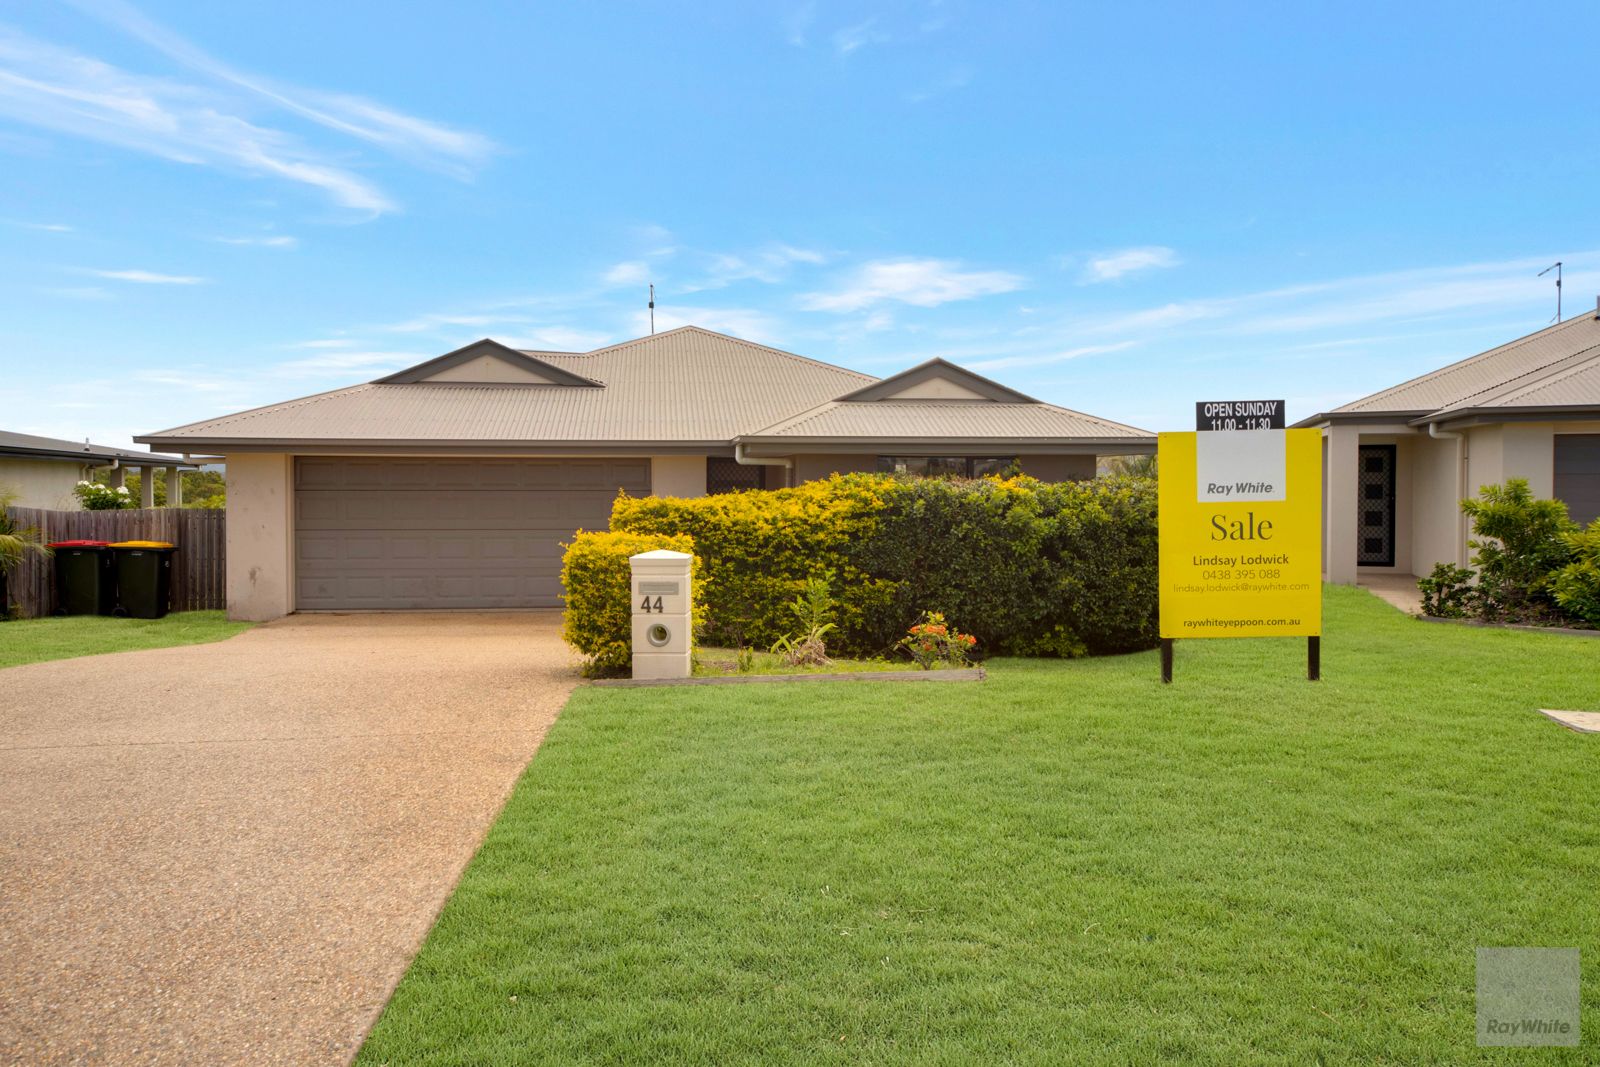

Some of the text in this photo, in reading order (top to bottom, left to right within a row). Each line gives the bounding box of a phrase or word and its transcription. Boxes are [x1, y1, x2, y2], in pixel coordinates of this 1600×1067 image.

[1204, 401, 1277, 417] OPEN SUNDAY
[1211, 418, 1236, 431] 11.00
[1245, 418, 1271, 430] 11.30
[1207, 482, 1273, 496] Ray White
[1211, 512, 1273, 541] Sale
[1193, 554, 1289, 568] Lindsay Lodwick
[1202, 569, 1281, 580] 0438 395 088
[1173, 583, 1310, 593] lindsay.lodwick@raywhite.com
[640, 596, 664, 613] 44
[1183, 618, 1301, 628] raywhiteyeppoon.com.au
